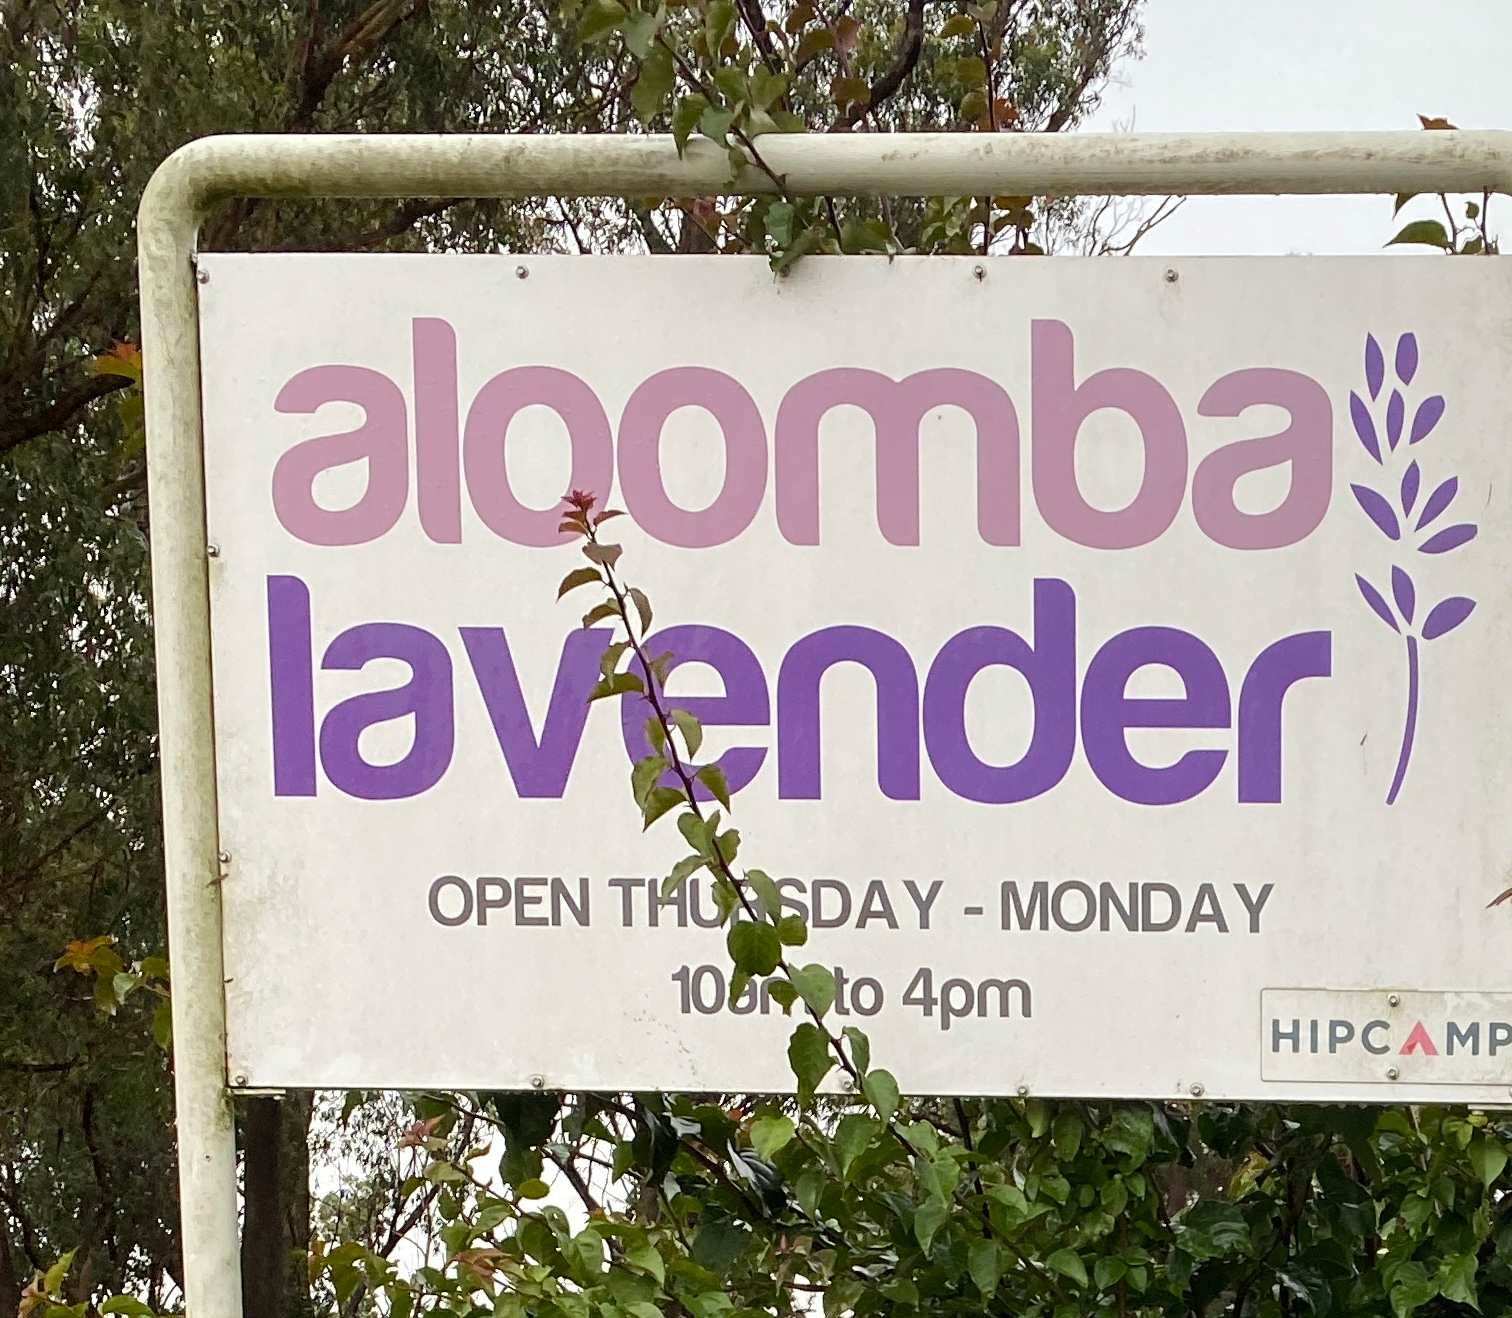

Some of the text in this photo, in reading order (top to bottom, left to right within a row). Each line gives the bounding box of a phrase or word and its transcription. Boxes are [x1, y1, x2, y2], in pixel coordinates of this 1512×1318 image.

[271, 317, 1333, 549] aloomba
[267, 574, 1331, 805] lavender
[428, 875, 591, 927] OPEN
[1000, 880, 1275, 934] MONDAY
[834, 967, 884, 1017] to
[902, 967, 1032, 1030] 4pm
